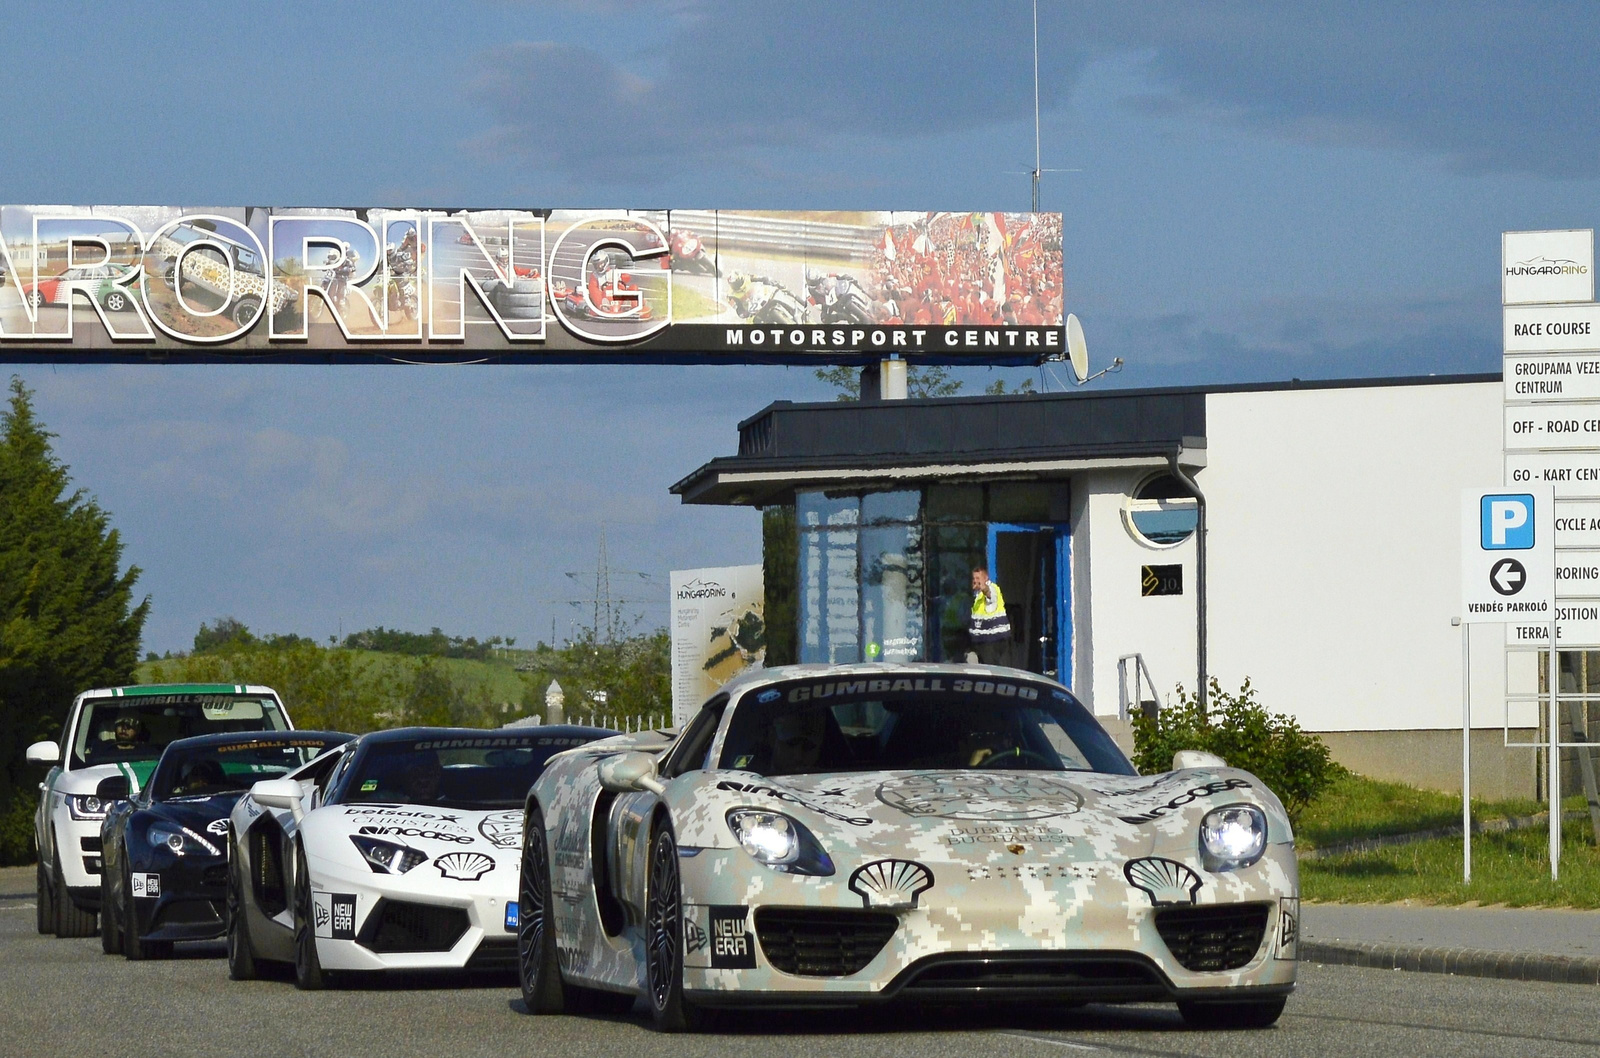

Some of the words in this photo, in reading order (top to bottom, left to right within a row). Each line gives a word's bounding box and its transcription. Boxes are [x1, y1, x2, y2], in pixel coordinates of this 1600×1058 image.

[1506, 265, 1588, 276] HUNGARORING
[1514, 323, 1542, 336] RACE
[1546, 322, 1591, 335] COURSE
[726, 329, 928, 346] MOTORSPORT
[944, 329, 1060, 346] CENTRE
[1515, 362, 1572, 376] GROUPAMA
[1515, 380, 1563, 394] CENTRUM
[1513, 421, 1535, 434] OFF
[1547, 420, 1580, 433] ROAD
[1513, 469, 1531, 482] GO
[1543, 468, 1572, 481] KART
[1491, 500, 1528, 545] P
[677, 588, 726, 600] HUNGARORING
[1468, 600, 1504, 613] VENDÉG
[1506, 599, 1548, 612] PARKOLÓ
[1516, 627, 1562, 639] TERRAE
[788, 679, 946, 702] GUMBALL
[953, 679, 1039, 700] 3000
[119, 695, 190, 708] GUMBALL
[193, 694, 234, 704] 3000
[218, 741, 286, 753] GUMBALL
[414, 738, 532, 750] GUMBALL
[344, 808, 436, 819] betsafe
[378, 826, 475, 845] incase
[951, 826, 1026, 836] DUBLIN
[1030, 826, 1064, 835] TO
[947, 834, 1076, 845] BUCHAREST
[334, 903, 352, 917] NEW
[334, 917, 352, 930] ERA
[714, 919, 746, 936] NEW
[715, 937, 747, 955] ERA
